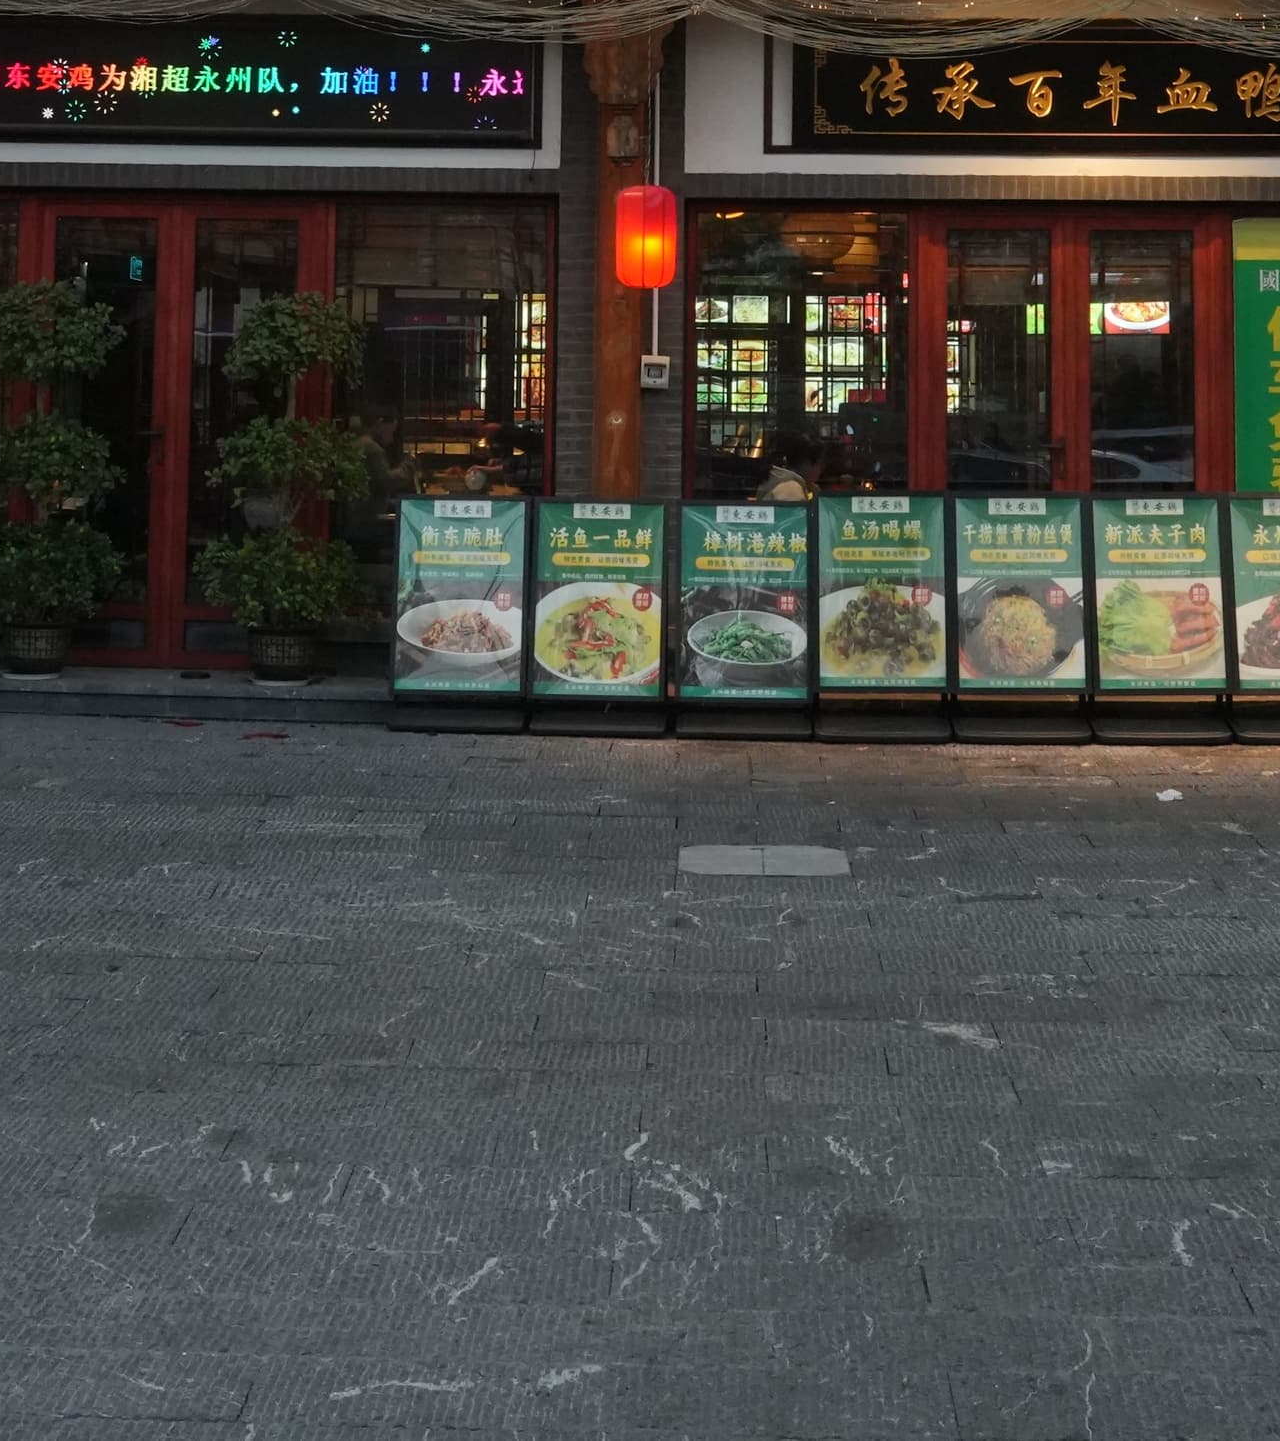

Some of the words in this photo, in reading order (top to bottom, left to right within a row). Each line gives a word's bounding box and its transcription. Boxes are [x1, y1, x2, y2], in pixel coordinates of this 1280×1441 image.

[549, 526, 654, 550] 活鱼一品鲜
[1105, 524, 1206, 545] 新派夫子肉
